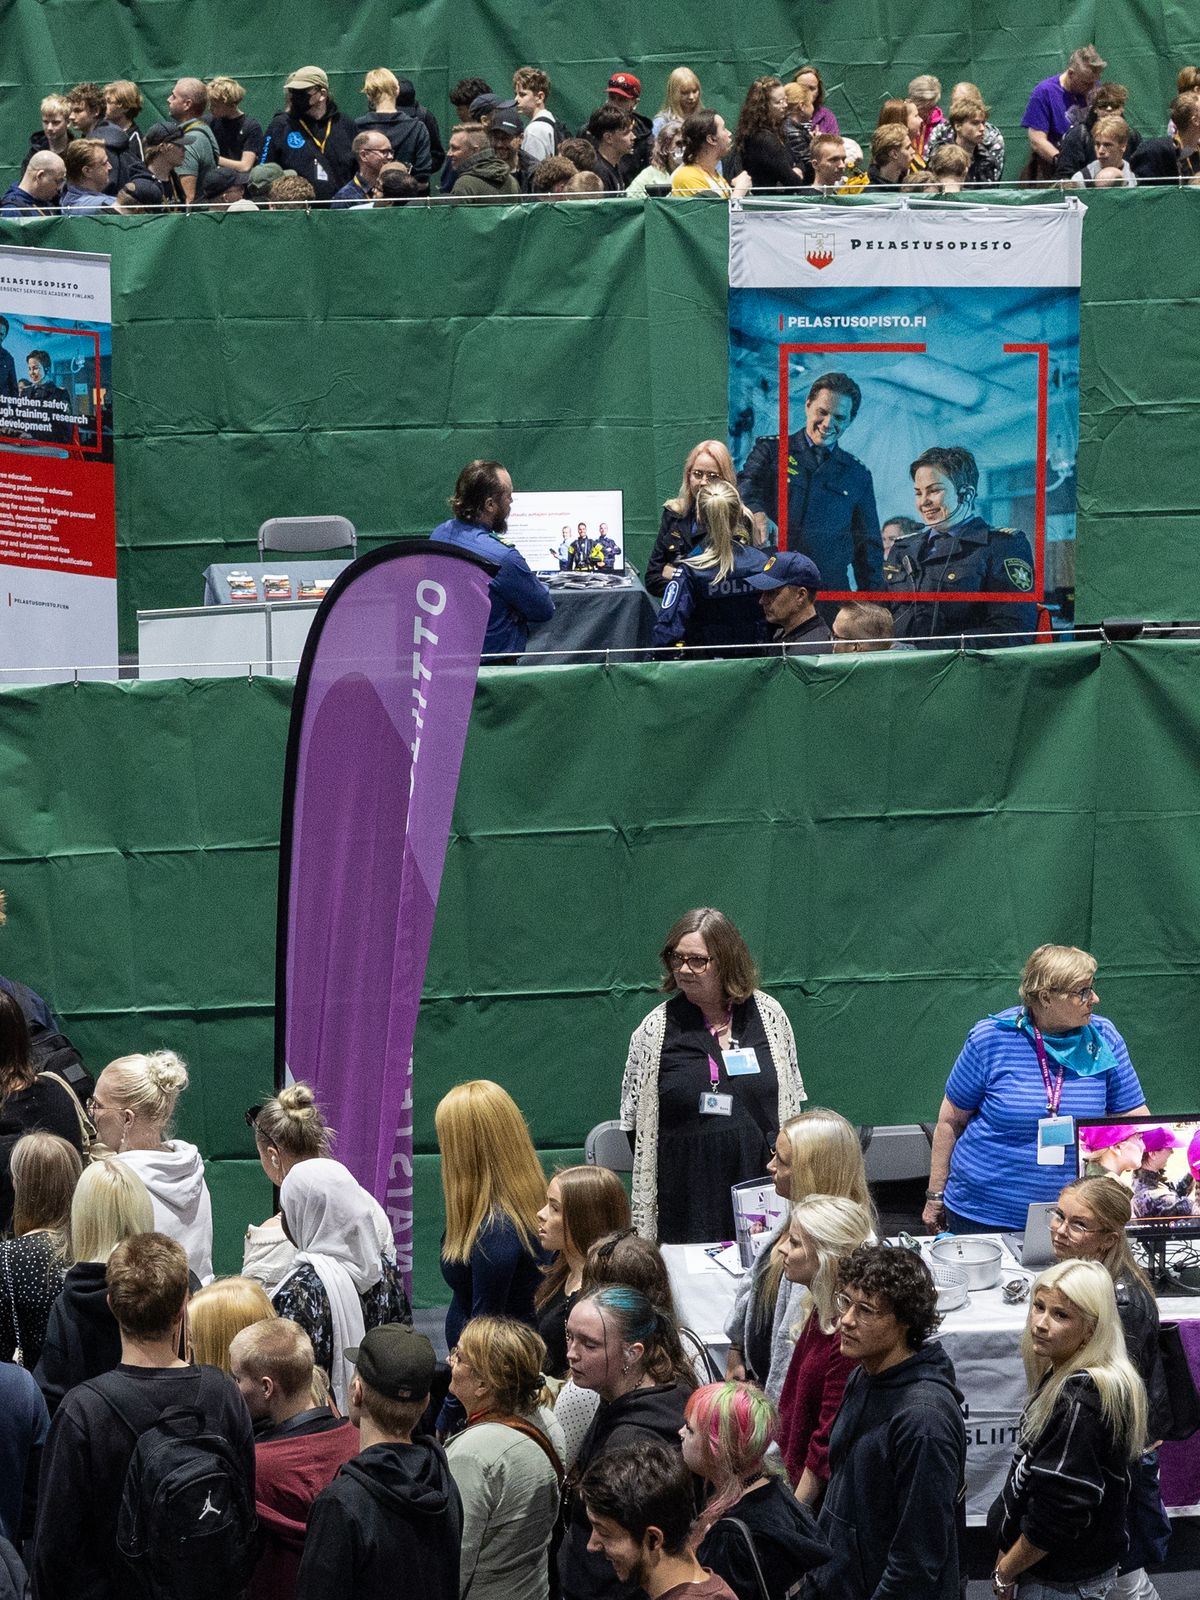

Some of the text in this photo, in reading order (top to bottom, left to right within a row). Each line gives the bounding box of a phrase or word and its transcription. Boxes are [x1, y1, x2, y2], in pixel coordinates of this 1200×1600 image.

[850, 239, 1012, 250] PELASTUSOPISTO
[23, 288, 48, 296] SERVICES
[787, 315, 927, 328] PELASTUSOPISTO.FI
[42, 399, 68, 412] safety
[15, 408, 50, 422] training,
[52, 412, 88, 425] research
[965, 1426, 1020, 1446] SLIIT
